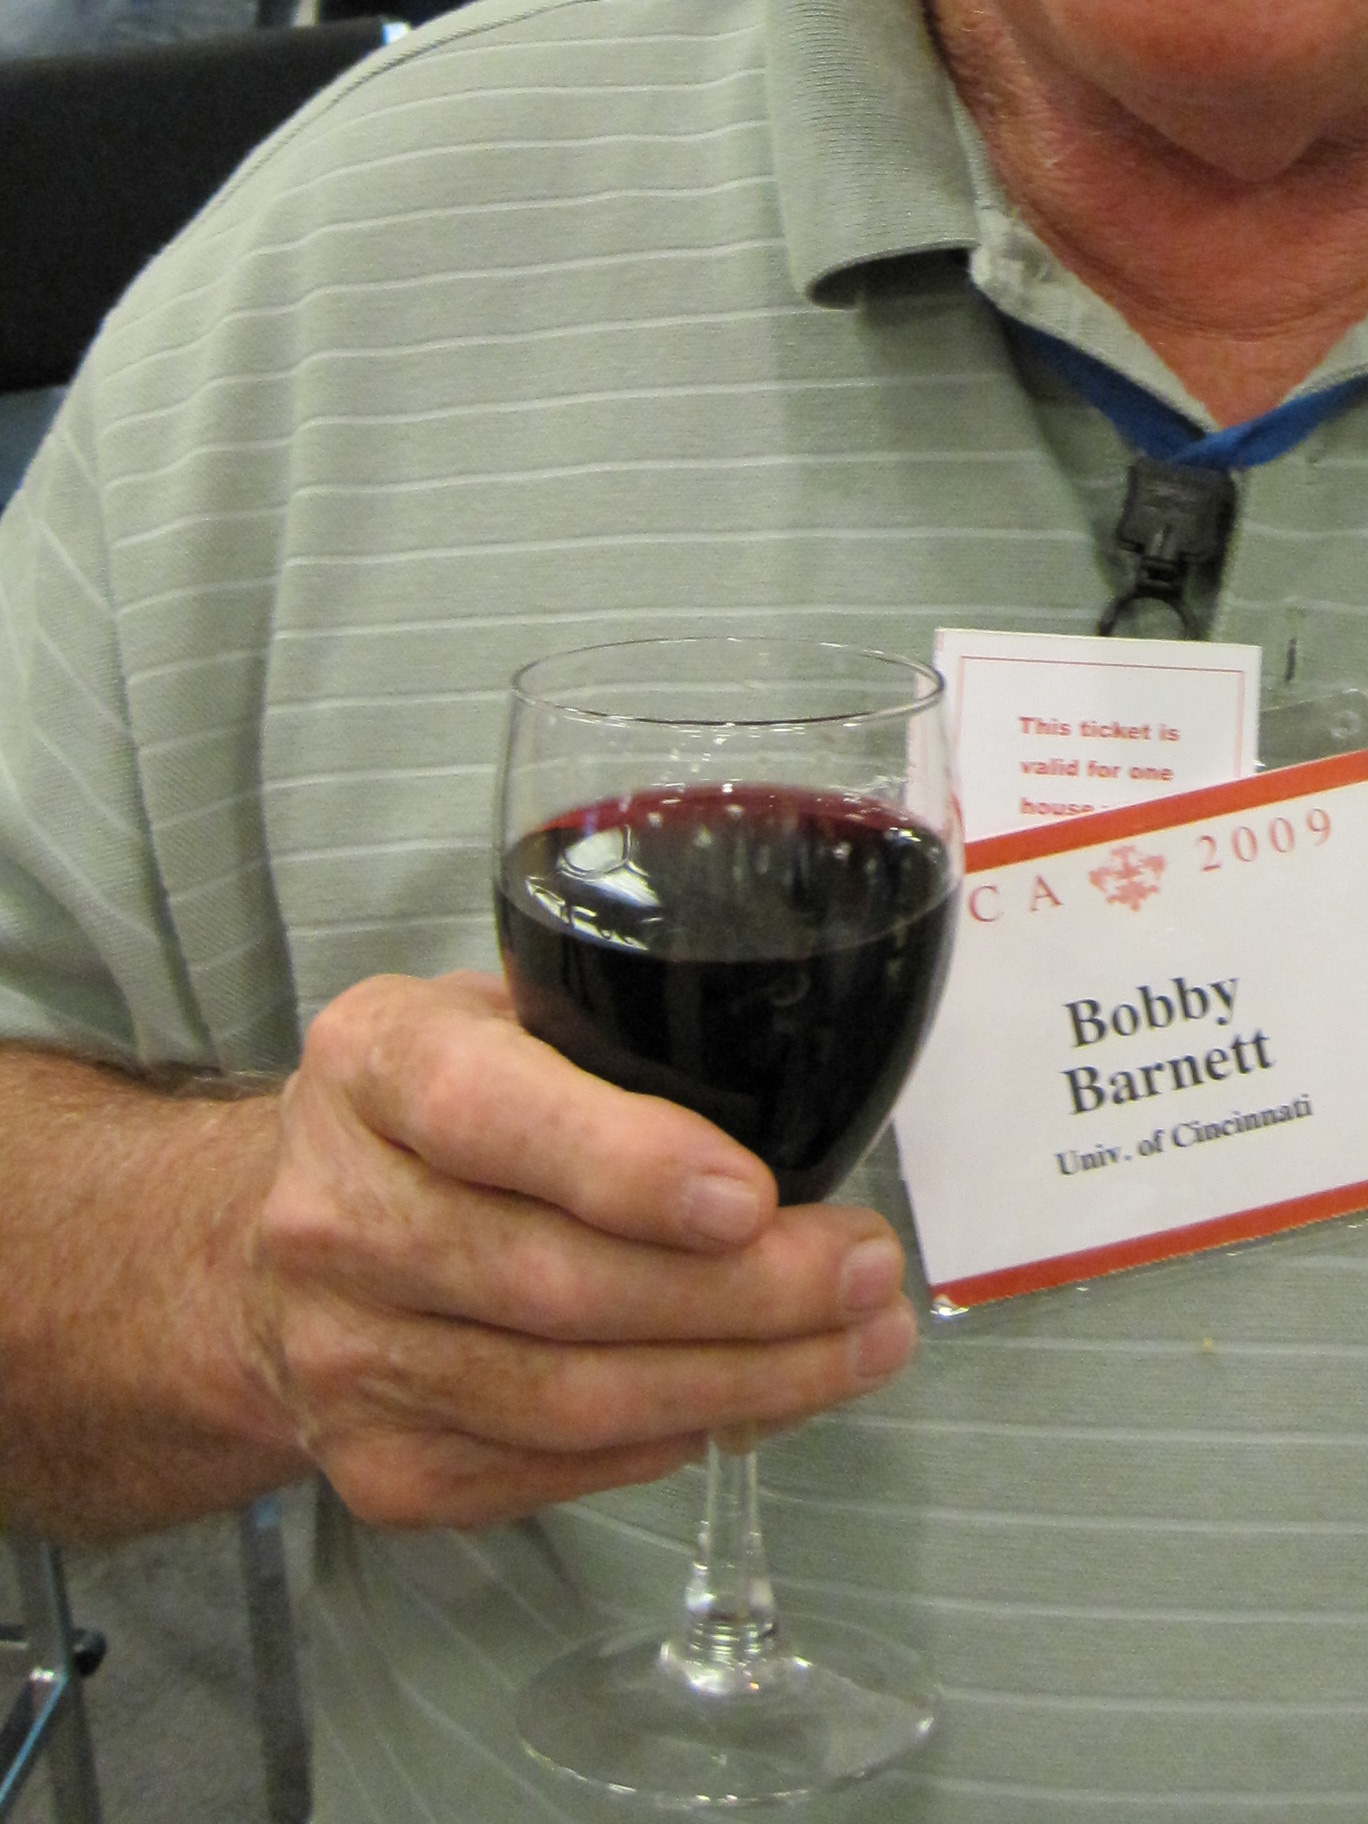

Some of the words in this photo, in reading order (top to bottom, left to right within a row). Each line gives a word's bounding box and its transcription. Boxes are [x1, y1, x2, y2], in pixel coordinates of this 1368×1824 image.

[1019, 716, 1071, 736] This
[1079, 719, 1152, 740] ticket
[1159, 723, 1180, 741] is
[1020, 758, 1078, 776] valid
[1086, 760, 1121, 778] for
[1128, 766, 1174, 781] one
[1019, 796, 1094, 815] house
[1196, 807, 1333, 873] 2009
[1062, 976, 1240, 1048] Bobby
[1059, 1028, 1277, 1115] Barnett
[1054, 1142, 1132, 1176] Univ.
[1137, 1128, 1165, 1157] of
[1171, 1092, 1314, 1148] Cincinnati
